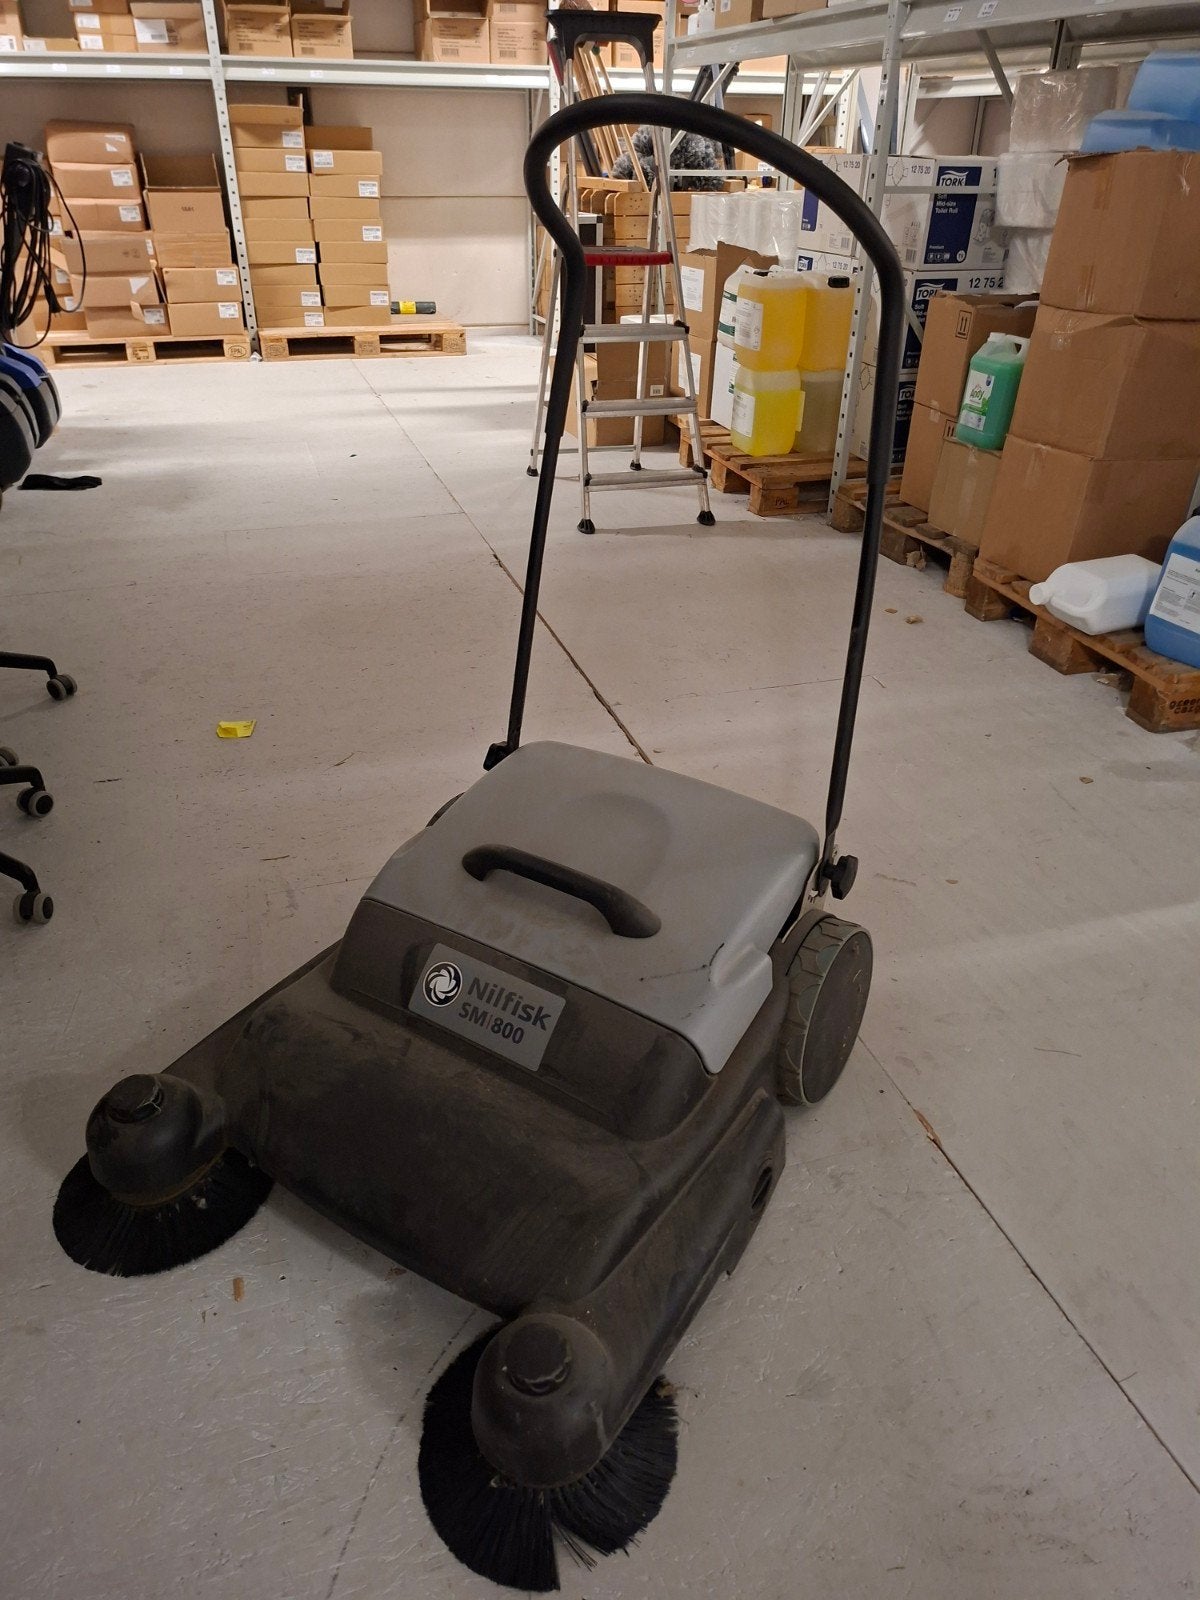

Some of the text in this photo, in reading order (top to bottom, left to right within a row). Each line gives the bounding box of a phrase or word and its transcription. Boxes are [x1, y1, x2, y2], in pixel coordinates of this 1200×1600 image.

[941, 177, 965, 187] TORK
[969, 276, 1004, 288] 12 75 2
[467, 977, 552, 1032] Nilfisk
